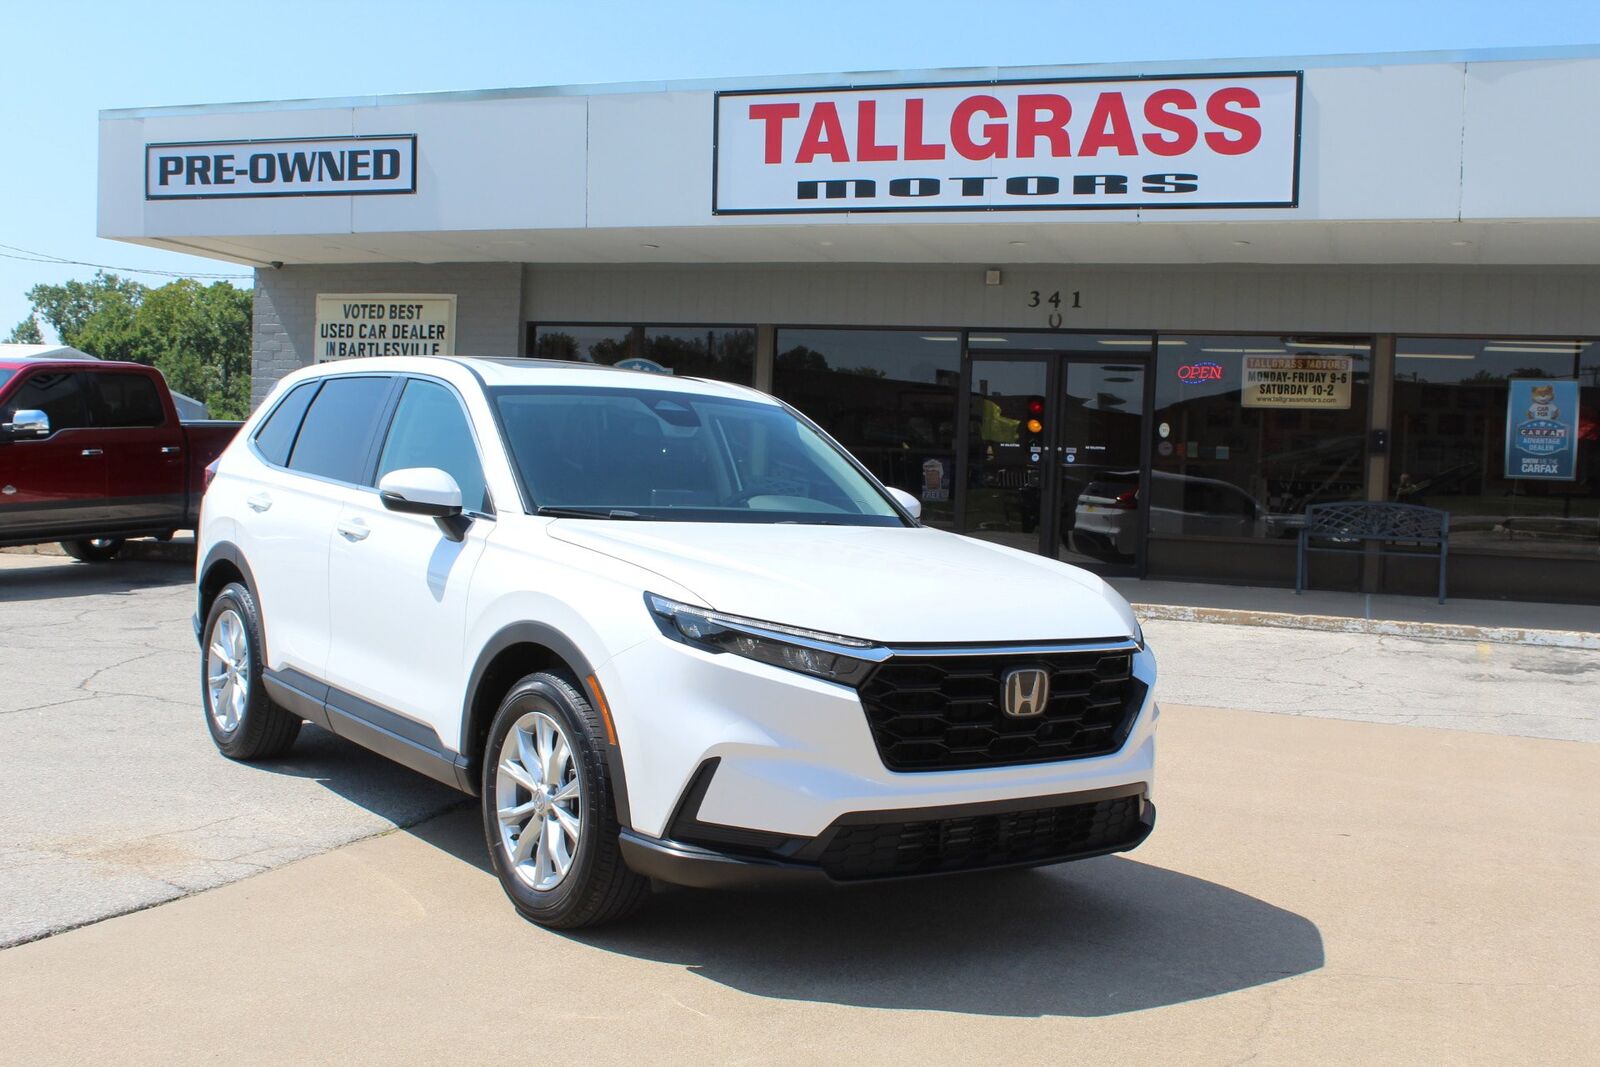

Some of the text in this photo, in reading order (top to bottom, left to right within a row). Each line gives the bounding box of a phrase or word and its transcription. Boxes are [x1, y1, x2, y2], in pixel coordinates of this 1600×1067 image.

[749, 87, 1262, 164] TALLGRASS
[158, 148, 400, 186] PRE-OWNED
[797, 173, 1199, 200] MOTORS
[343, 303, 423, 320] VOTED BEST
[321, 323, 446, 340] USED CAR DEALER
[338, 342, 440, 357] BARTLESVILLE
[1177, 365, 1223, 379] OPEN
[1249, 358, 1351, 371] TALLGRASS MOTORS
[1247, 371, 1348, 384] MONDAY-FRIDAY 9-6
[1259, 384, 1335, 396] SATURDAY 10-2
[1521, 464, 1559, 474] CARFAX
